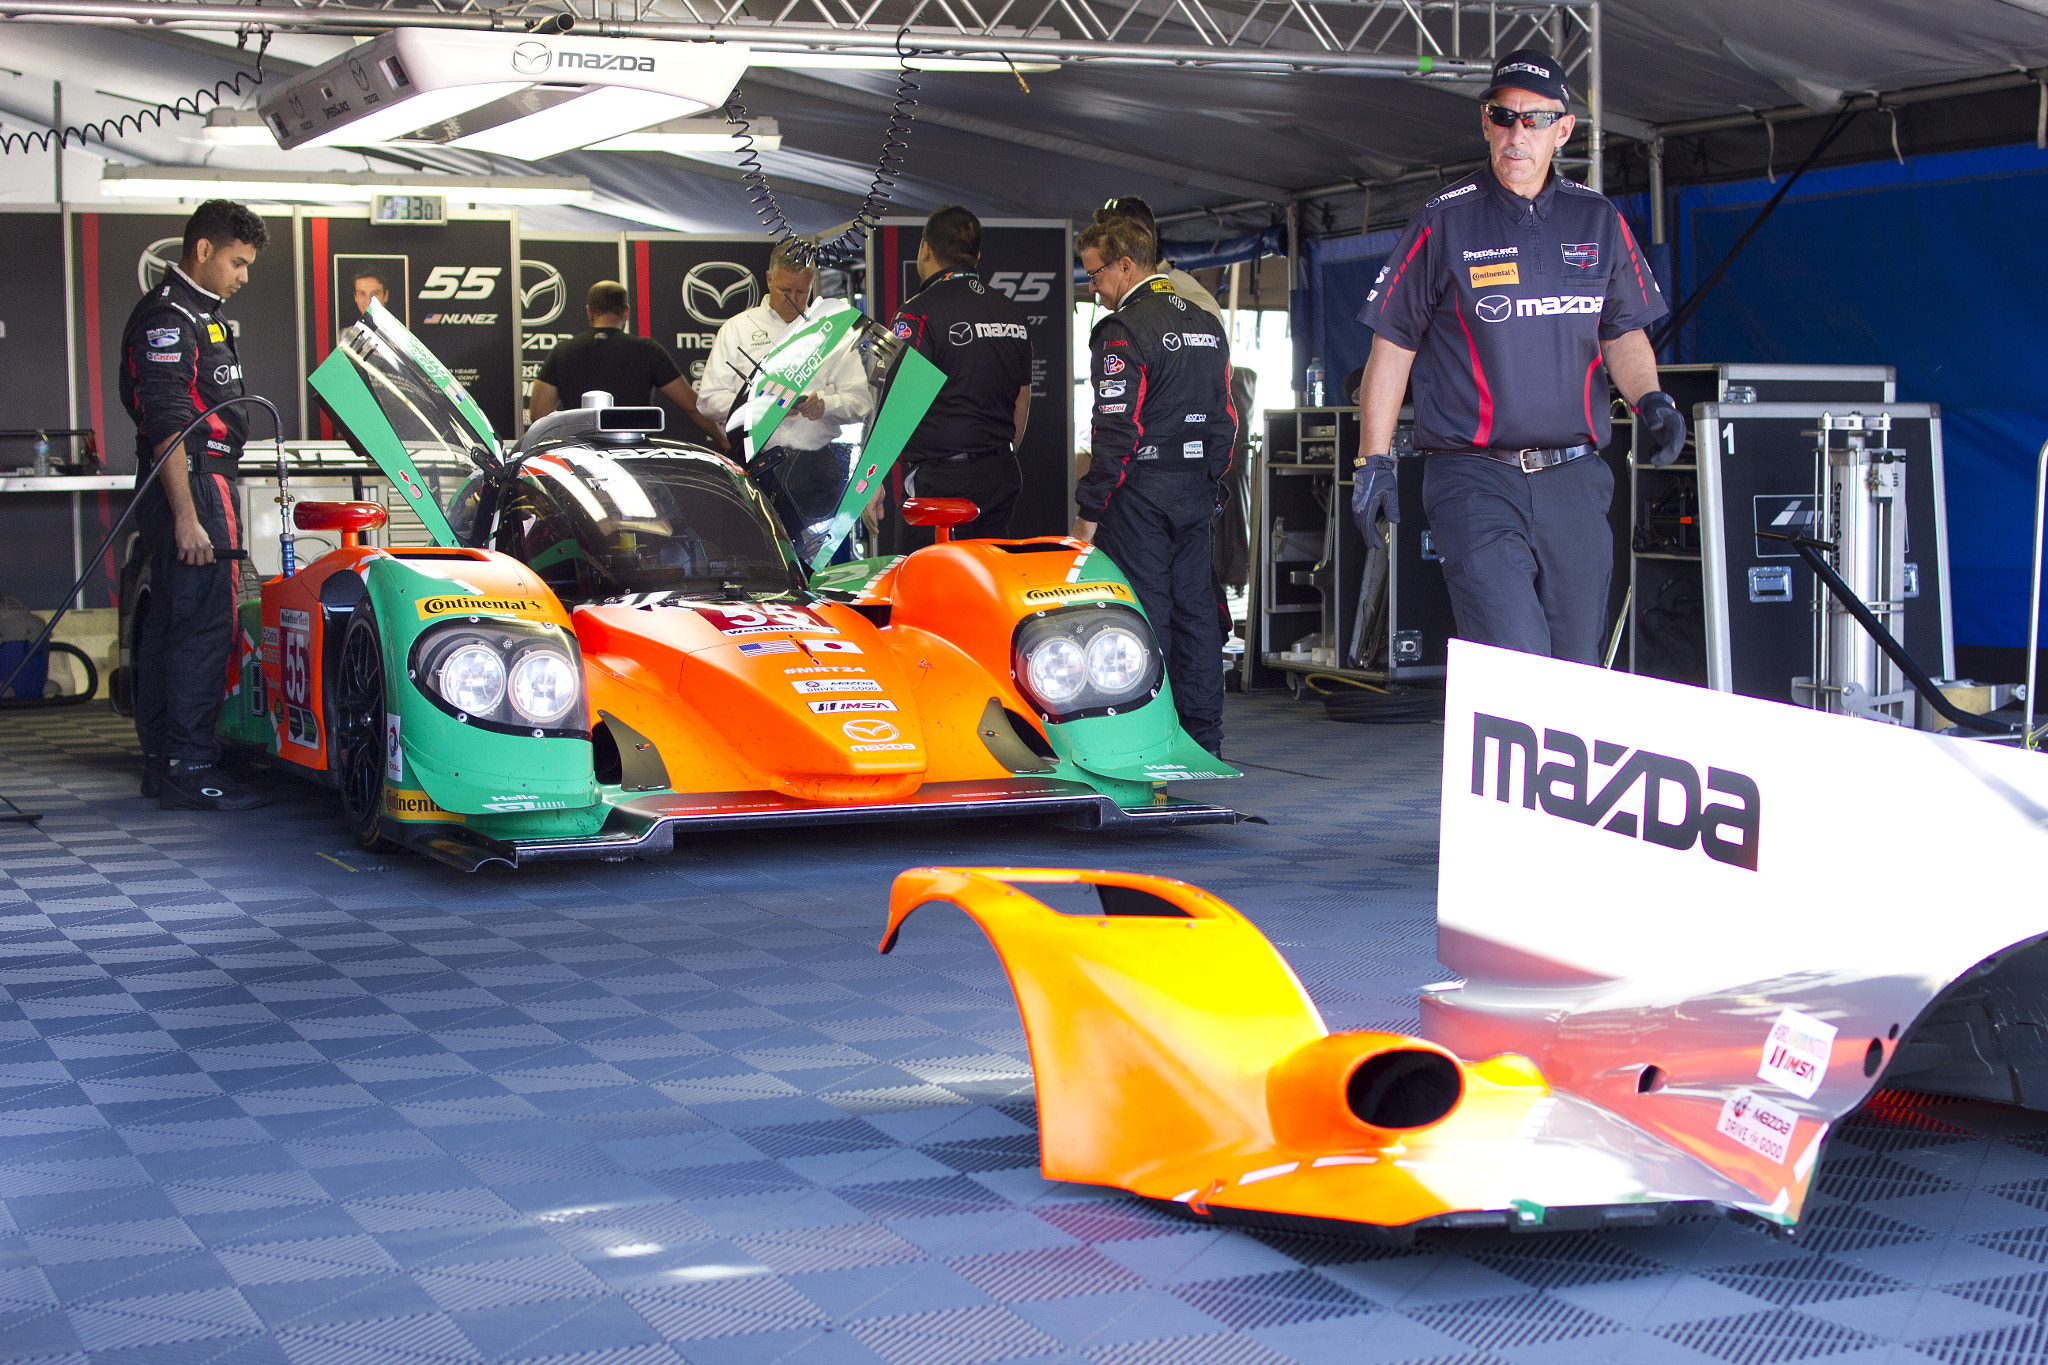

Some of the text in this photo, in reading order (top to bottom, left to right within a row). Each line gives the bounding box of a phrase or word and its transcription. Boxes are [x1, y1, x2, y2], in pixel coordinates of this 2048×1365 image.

[557, 51, 656, 73] mazda
[418, 266, 502, 300] 55
[440, 313, 499, 324] NUNEZ
[974, 322, 1028, 340] mazda
[1722, 422, 1735, 455] 1
[1026, 584, 1116, 600] Continental
[423, 597, 527, 614] Continental
[720, 603, 811, 627] 55
[286, 632, 306, 704] 55
[783, 666, 866, 675] #MRT24
[849, 742, 916, 753] mazda
[1470, 710, 1761, 872] mazda
